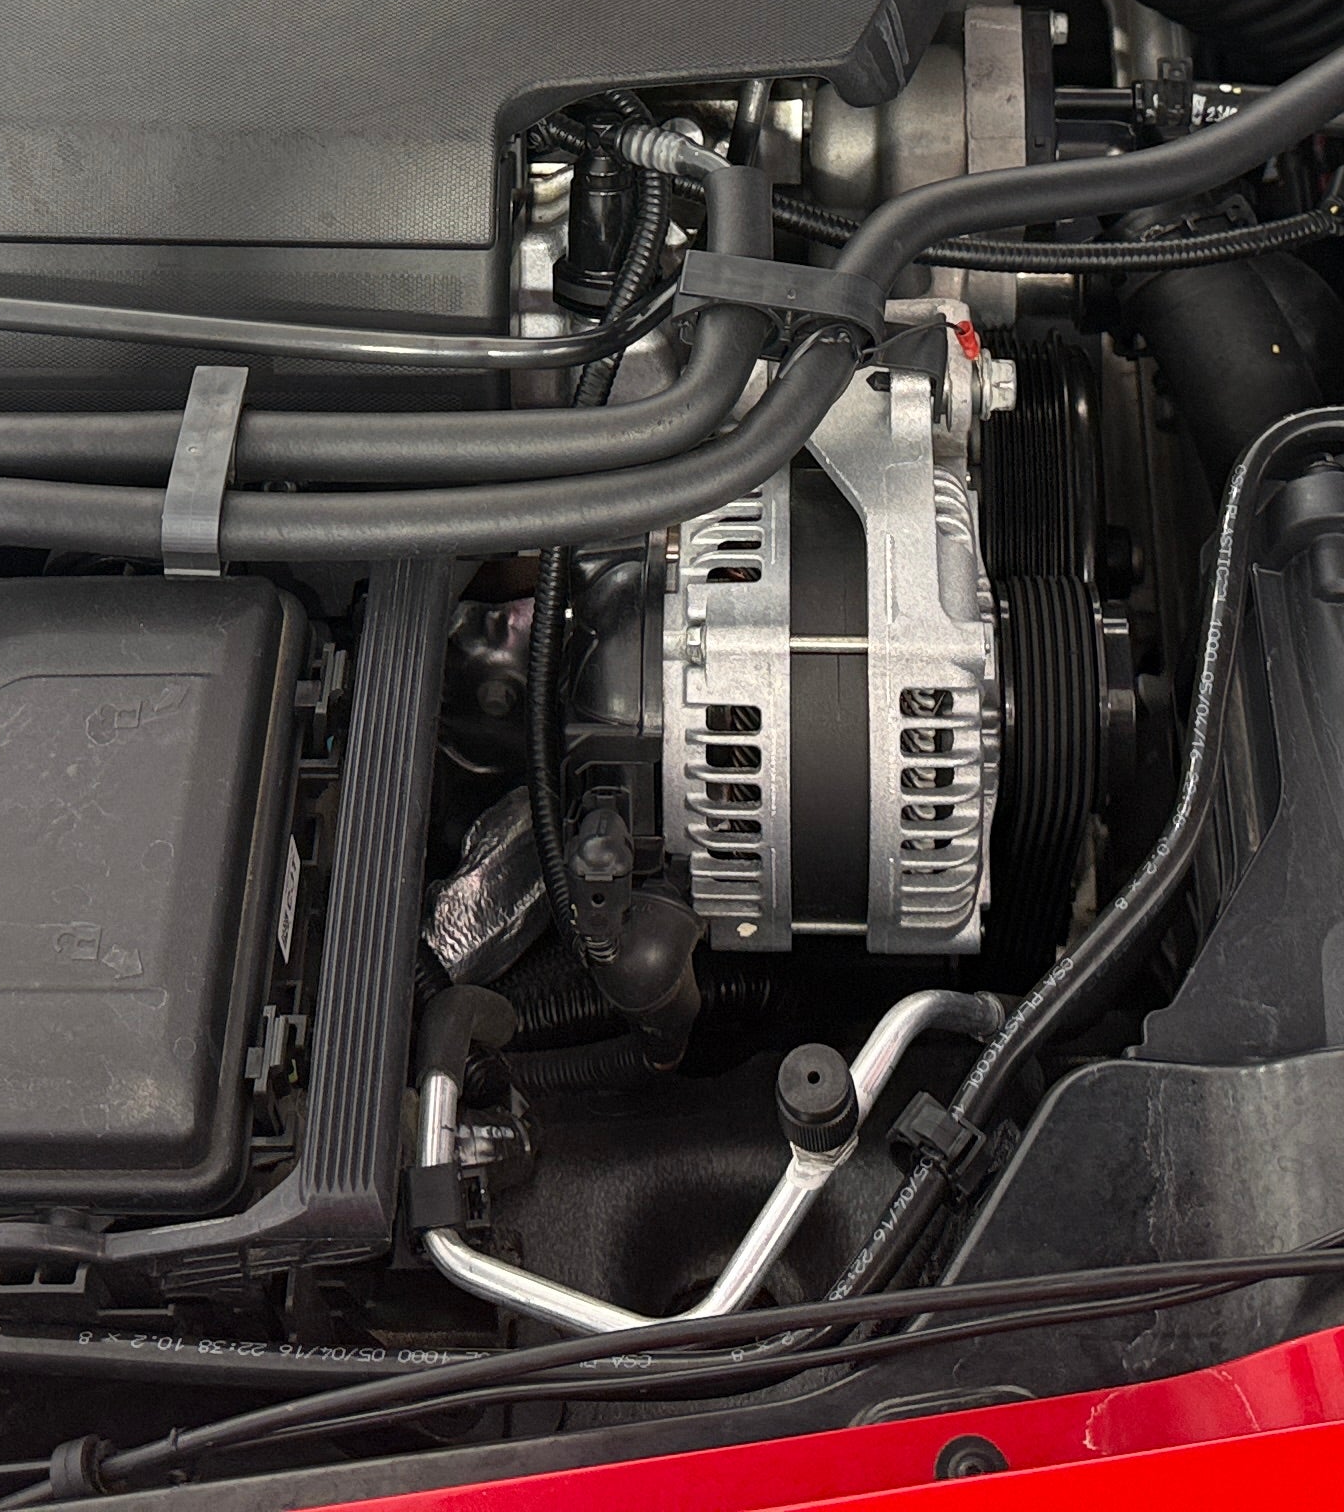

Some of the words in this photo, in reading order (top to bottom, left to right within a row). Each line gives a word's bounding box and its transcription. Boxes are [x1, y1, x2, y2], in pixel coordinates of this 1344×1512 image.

[1204, 619, 1223, 662] 1000
[1190, 672, 1214, 760] 05/04/16
[1115, 897, 1129, 910] 8
[1043, 957, 1074, 987] CSA
[963, 991, 1044, 1092] PLASTICOOL
[873, 1156, 933, 1242] 05/04/16
[78, 1331, 93, 1345] 8
[130, 1333, 185, 1352] 10.2
[197, 1339, 268, 1357] 22:38
[279, 1344, 386, 1362] 05/04/16
[397, 1350, 451, 1366] 1000
